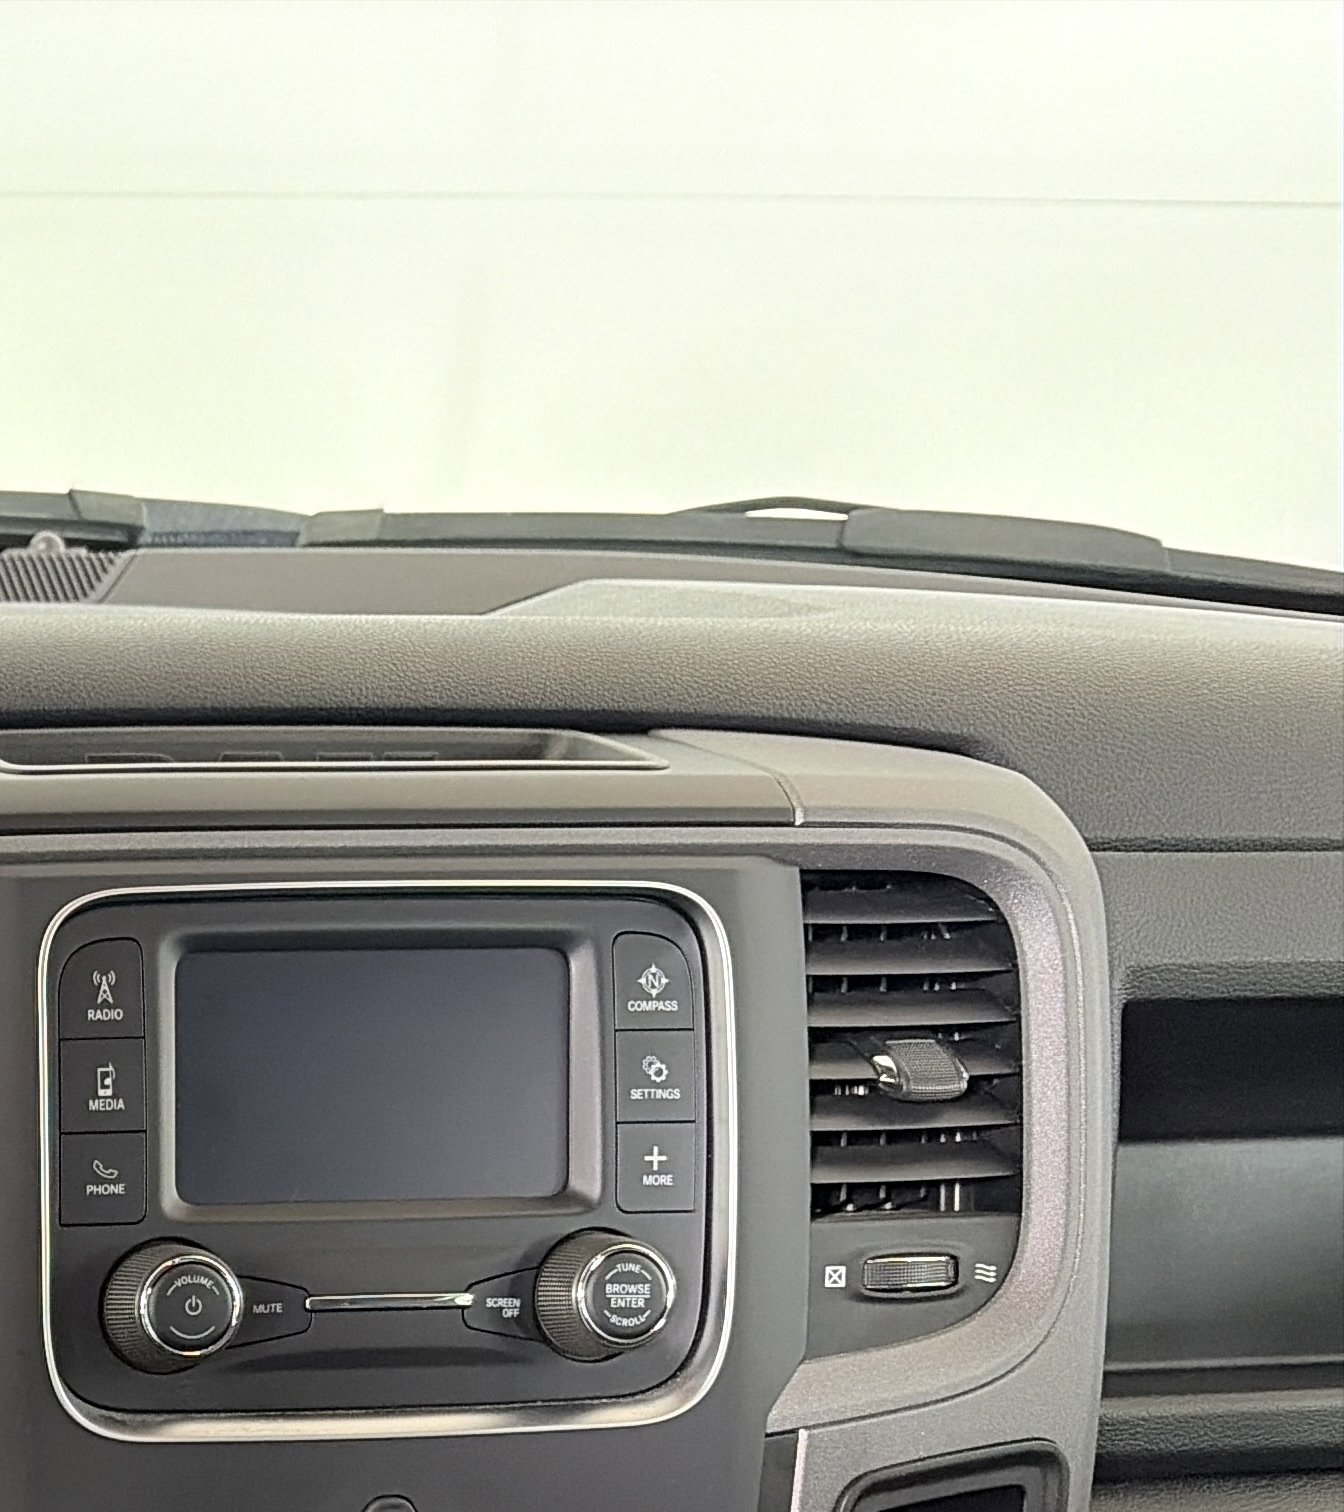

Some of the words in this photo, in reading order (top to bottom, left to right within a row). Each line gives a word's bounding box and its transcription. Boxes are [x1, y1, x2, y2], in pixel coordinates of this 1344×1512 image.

[627, 1000, 679, 1012] COMPASS
[87, 1009, 124, 1021] RADIO
[630, 1088, 681, 1100] SETTINGS
[88, 1099, 125, 1111] MEDIA
[642, 1175, 674, 1186] MORE
[86, 1184, 126, 1195] PHONE
[616, 1263, 642, 1274] TUNE
[174, 1275, 214, 1289] VOLUME
[605, 1283, 651, 1295] BROWSE
[252, 1303, 283, 1314] MUTE
[485, 1297, 521, 1309] SCREEN
[610, 1297, 645, 1309] ENTER
[502, 1308, 520, 1319] OFF
[609, 1313, 647, 1327] SCROLL
